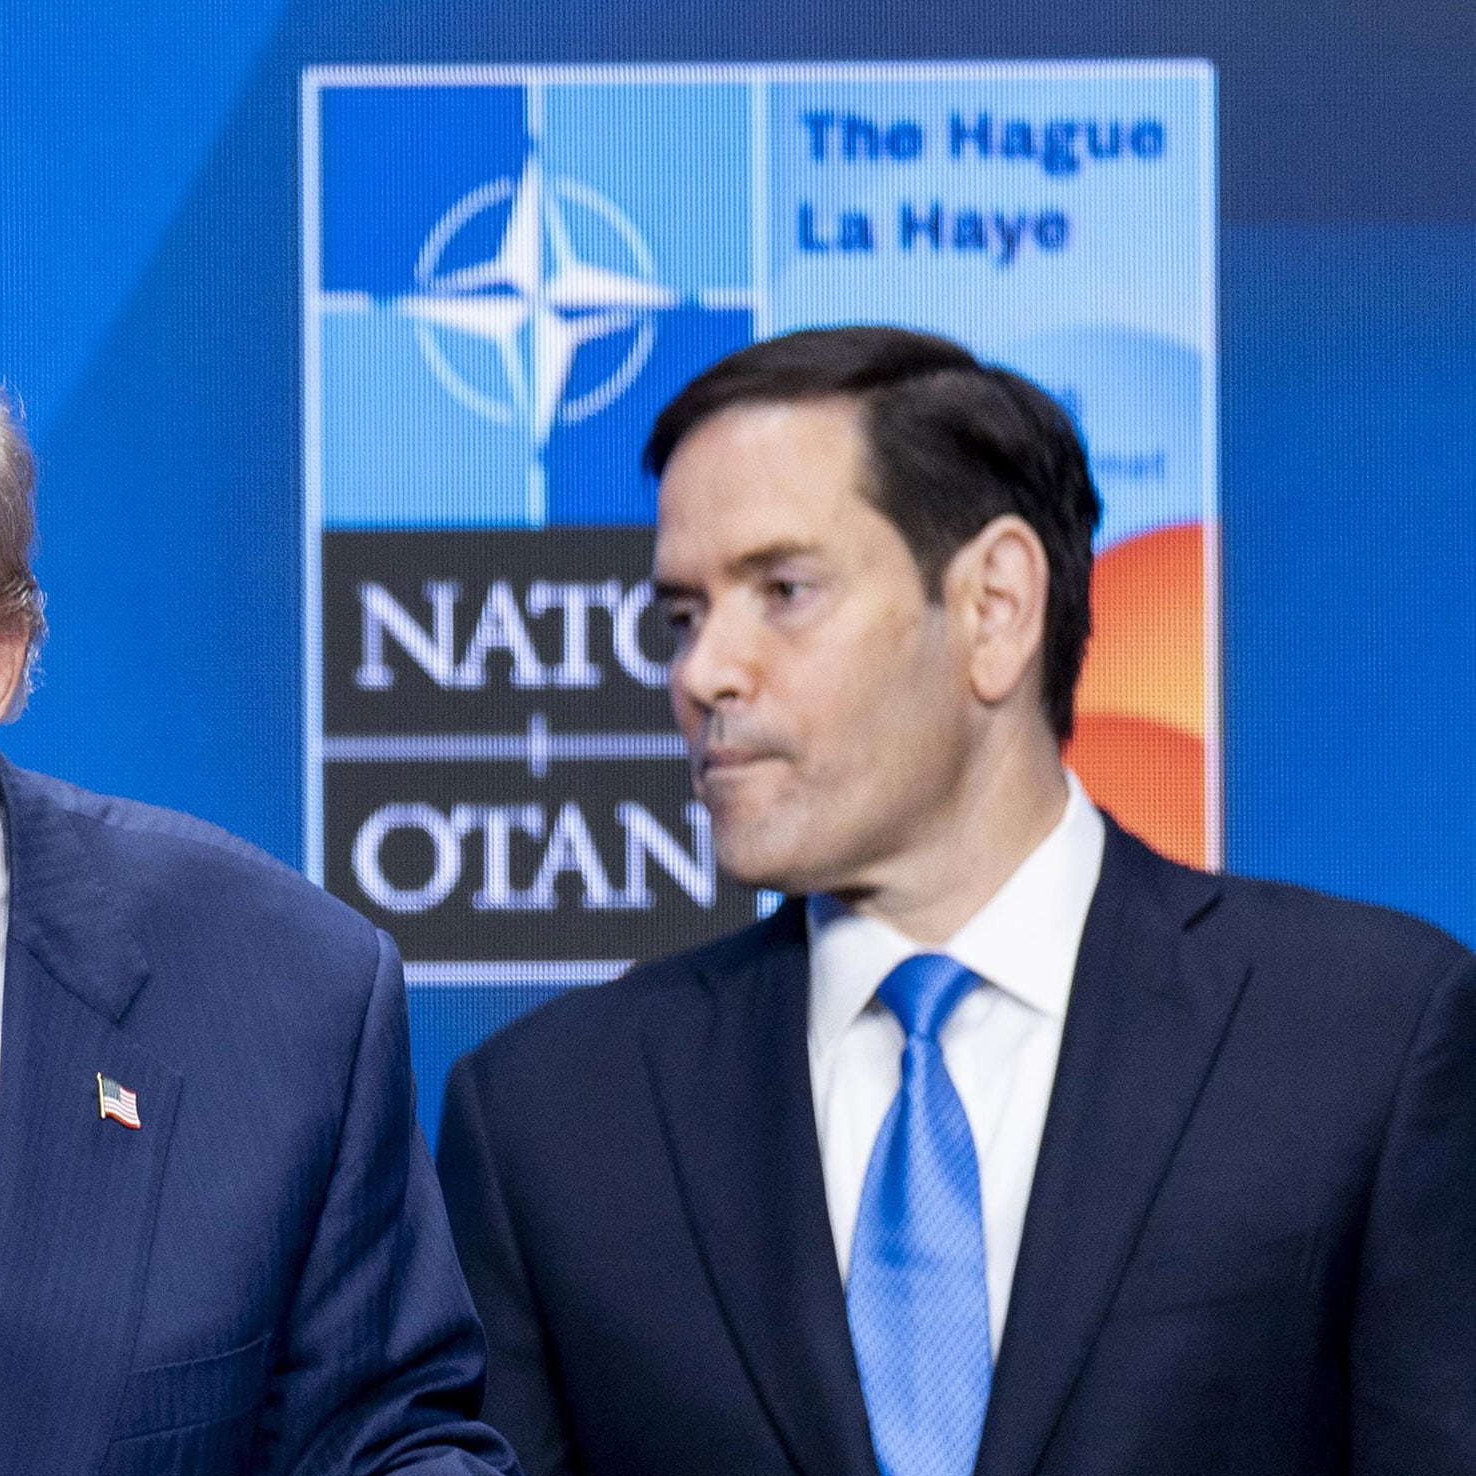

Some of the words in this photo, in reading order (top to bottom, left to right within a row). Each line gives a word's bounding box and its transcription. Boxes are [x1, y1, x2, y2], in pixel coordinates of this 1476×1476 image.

[800, 110, 922, 163] The
[948, 110, 1166, 178] Hague
[799, 202, 875, 257] La
[899, 202, 1071, 270] Haye
[351, 801, 716, 915] OTAN
